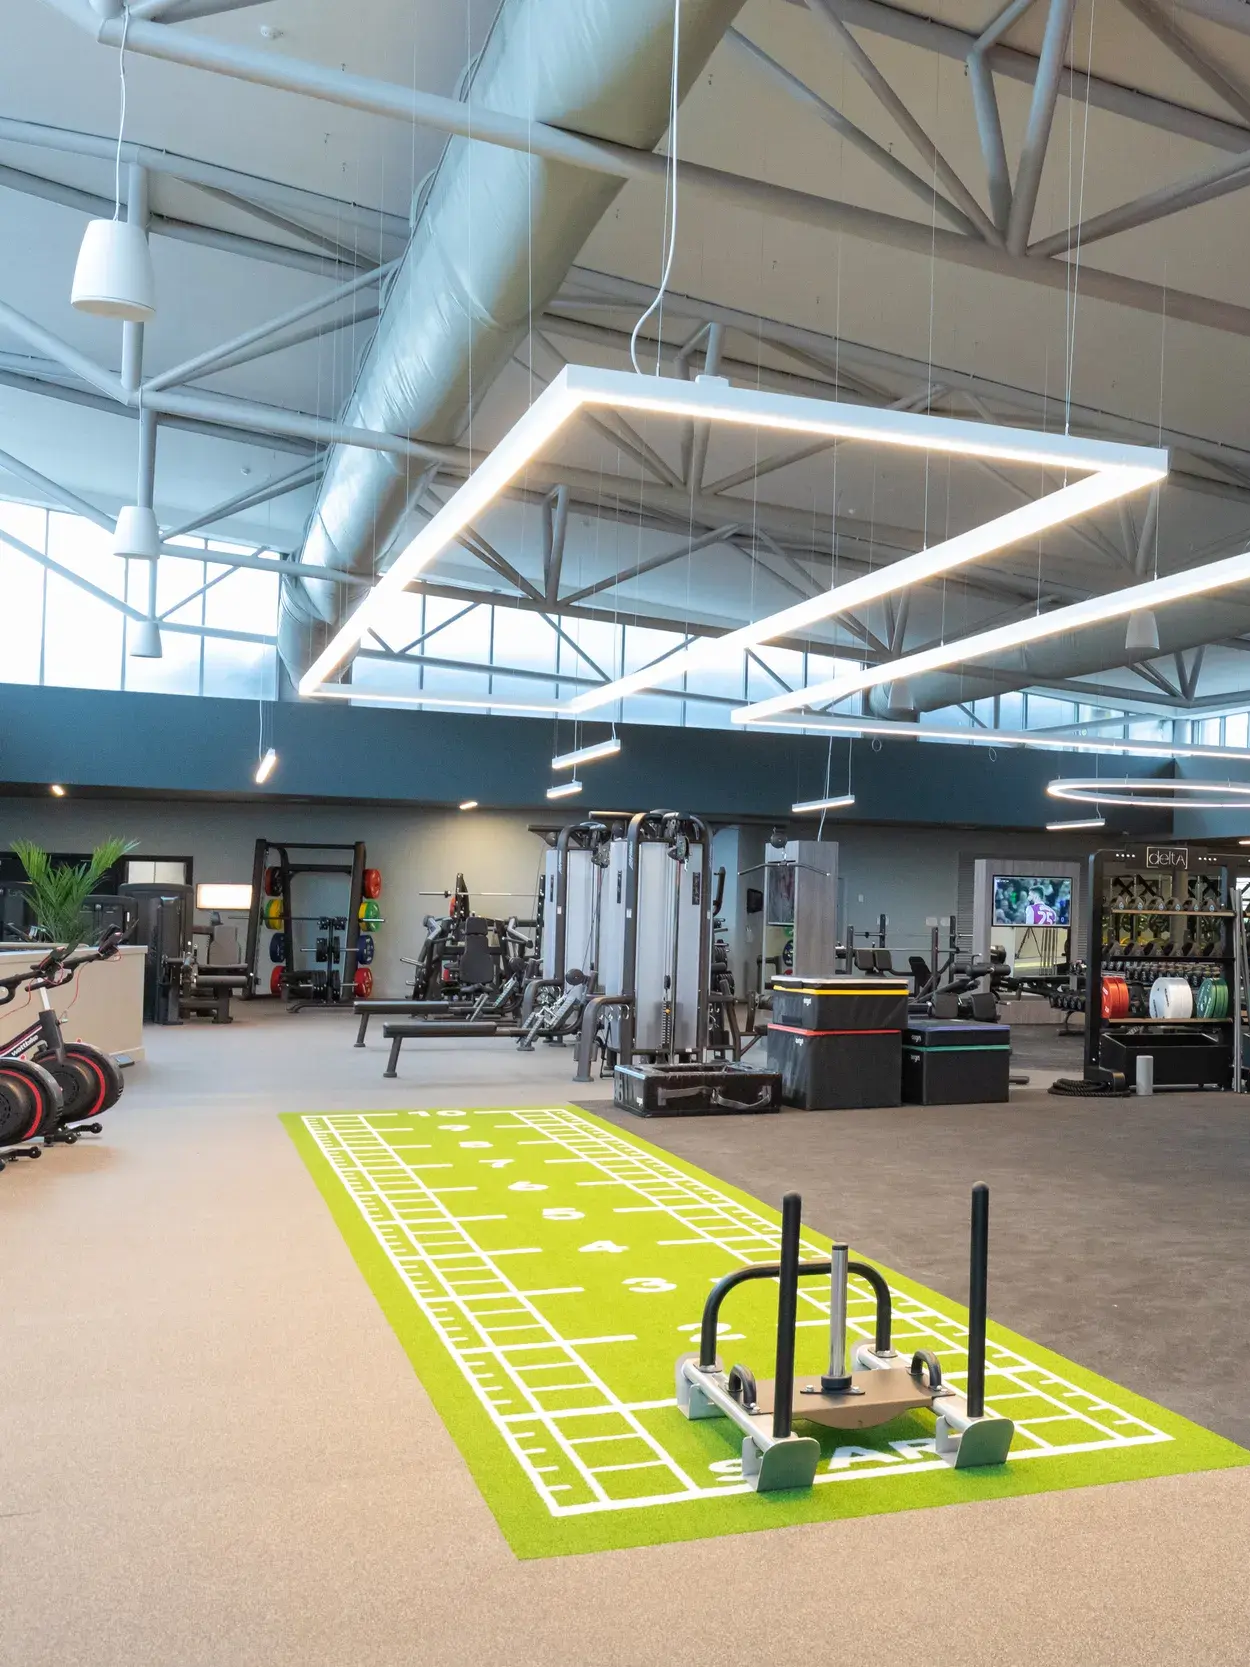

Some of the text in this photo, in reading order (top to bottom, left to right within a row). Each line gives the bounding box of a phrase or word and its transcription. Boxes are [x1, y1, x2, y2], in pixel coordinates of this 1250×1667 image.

[478, 1159, 515, 1168] 7
[507, 1180, 549, 1191] 6
[542, 1207, 586, 1220] 5
[578, 1240, 629, 1253] 4
[621, 1277, 678, 1293] 3
[676, 1322, 747, 1342] 2
